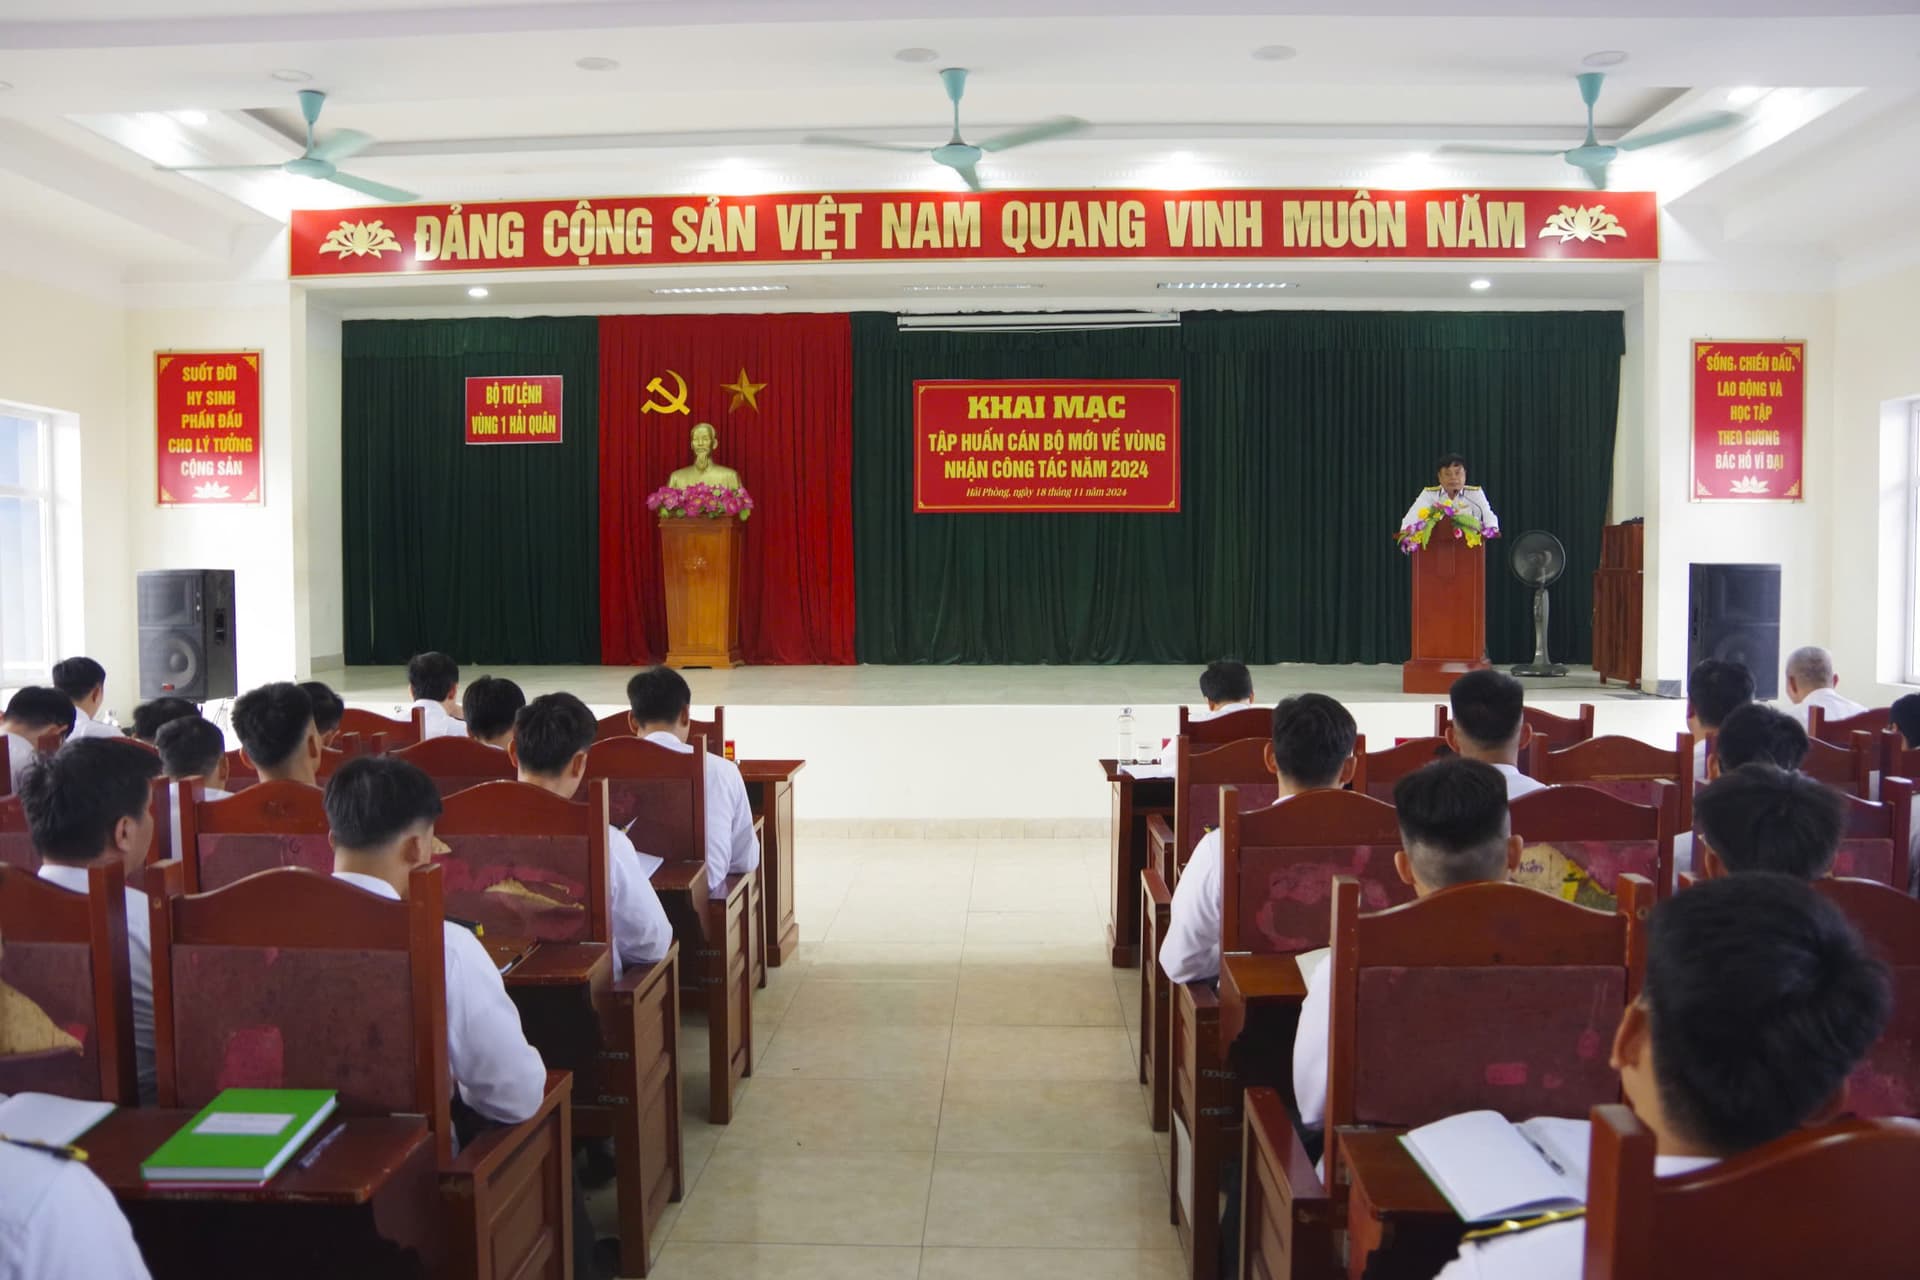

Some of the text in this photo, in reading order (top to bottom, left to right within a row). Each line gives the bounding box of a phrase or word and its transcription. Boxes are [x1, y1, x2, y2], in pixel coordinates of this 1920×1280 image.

[414, 190, 1525, 265] ĐẢNG CỘNG SẢN VIỆT NAM QUANG VINH MUÔN NĂM
[182, 361, 237, 381] SUỐT ĐỜI
[1739, 352, 1769, 372] CHIẾN
[1772, 352, 1796, 372] ĐẤU,
[187, 390, 235, 406] HY SINH
[486, 381, 542, 408] BỘ TƯ LỆNH
[1717, 378, 1783, 399] LAO ĐỘNG VÀ
[181, 409, 243, 429] PHẤN ĐẤU
[968, 396, 1126, 423] KHAI MẠC
[1730, 403, 1772, 423] HỌC TẬP
[472, 409, 556, 436] VÙNG 1 HẢI QUÂN
[168, 432, 253, 454] CHO LÝ TƯỞNG
[928, 430, 957, 456] TẬP
[961, 427, 1004, 452] HUẤN
[1008, 429, 1039, 452] CÁN
[1044, 429, 1064, 455] BỘ
[1068, 428, 1098, 452] MỚI
[1124, 429, 1166, 452] VÙNG
[1718, 430, 1780, 446] THEO GƯƠNG
[181, 456, 243, 479] CỘNG SẢN
[945, 456, 1149, 482] NHẬN CÔNG TÁC NĂM 2024
[1715, 449, 1783, 472] BÁC HỒ VĨ ĐẠI
[966, 487, 981, 497] Hải
[1013, 487, 1033, 499] ngày
[1036, 487, 1046, 497] 18
[1047, 487, 1072, 499] tháng
[1074, 487, 1084, 497] 11
[1086, 487, 1104, 497] năm
[1106, 487, 1127, 497] 2024
